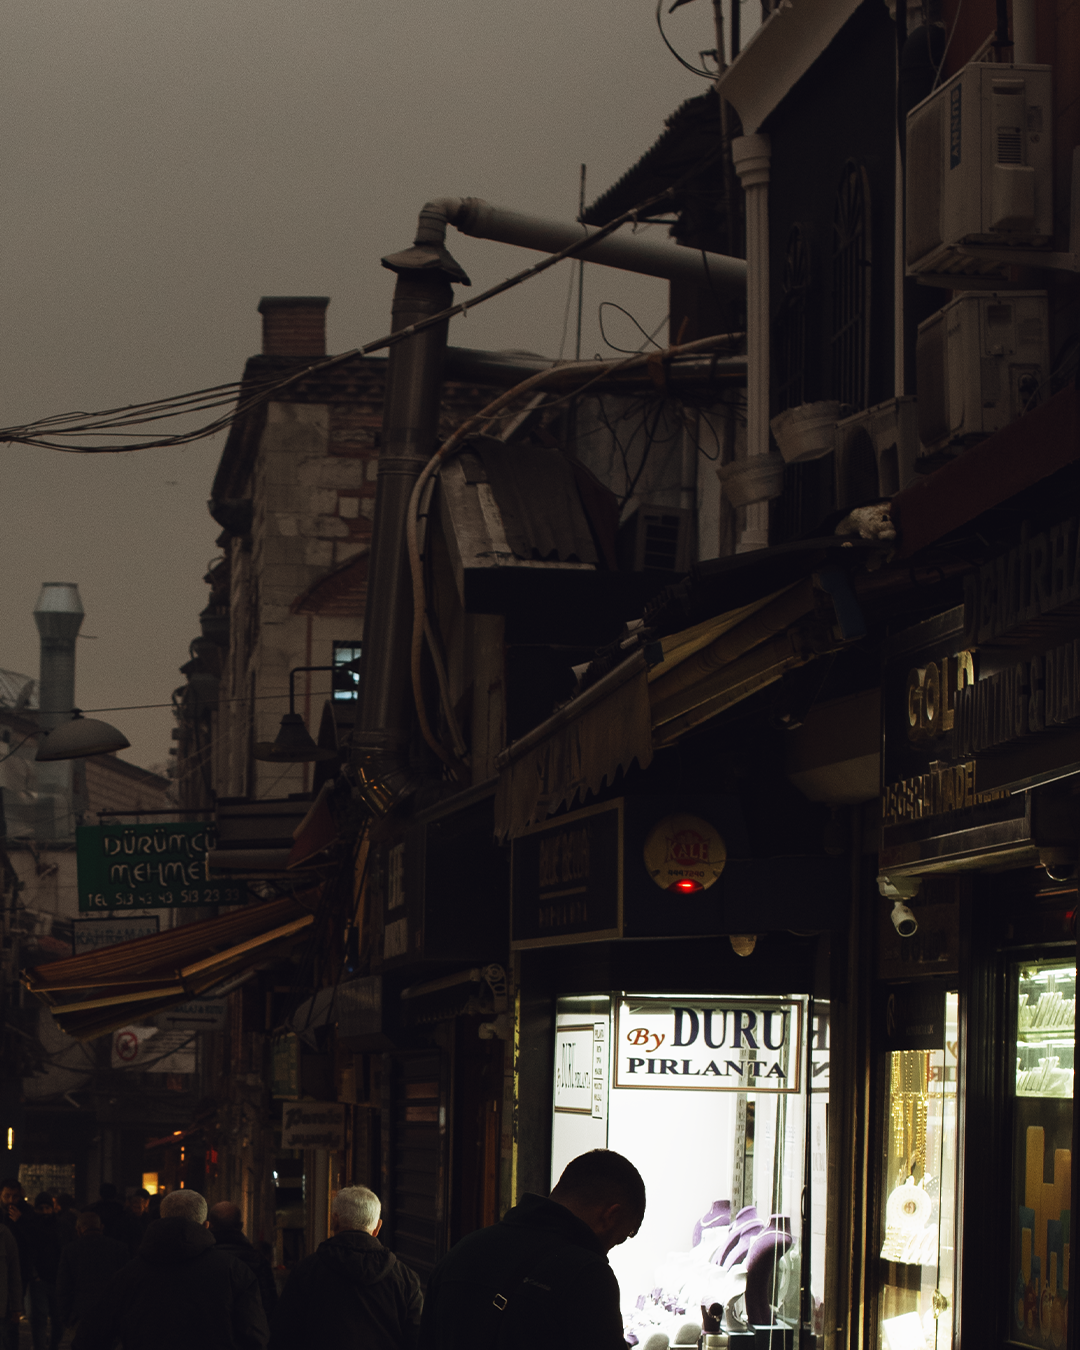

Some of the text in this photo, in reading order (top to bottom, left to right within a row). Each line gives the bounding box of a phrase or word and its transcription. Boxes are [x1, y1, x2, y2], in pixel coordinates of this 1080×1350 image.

[951, 89, 961, 157] SUNNY
[104, 826, 217, 859] DÜRÜMCÜ
[666, 839, 709, 862] KALE
[627, 1028, 666, 1053] By
[670, 1007, 791, 1051] DURU
[626, 1057, 787, 1079] PIRLANTA
